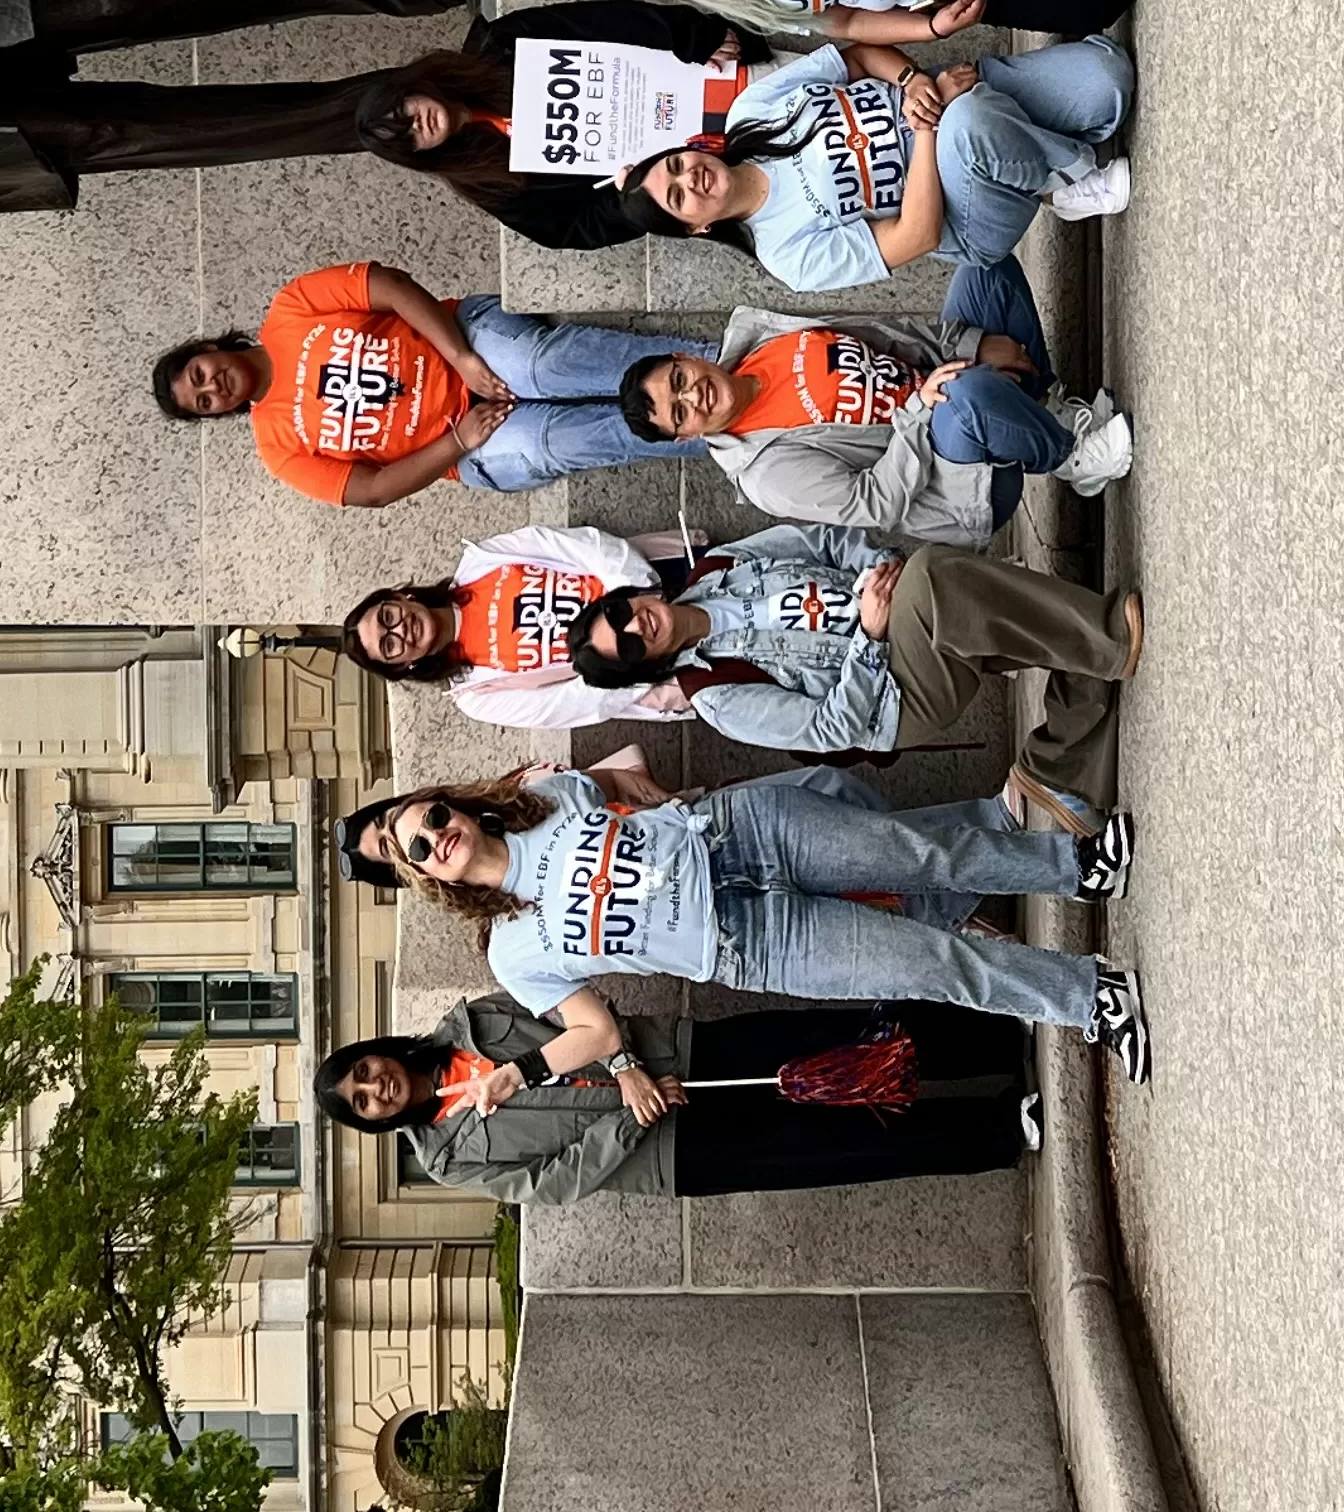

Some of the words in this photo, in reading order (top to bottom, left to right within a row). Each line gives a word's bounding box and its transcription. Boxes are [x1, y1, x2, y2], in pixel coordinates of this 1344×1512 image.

[542, 48, 582, 165] $550M
[586, 51, 604, 99] EBF
[608, 56, 621, 160] #FundtheFormula
[664, 92, 674, 130] FUTURE
[584, 112, 603, 162] FOR
[802, 84, 863, 216] FUNDING
[845, 82, 902, 210] FUTURE
[295, 360, 306, 385] EBF
[318, 328, 354, 450] FUNDING
[352, 334, 388, 452] FUTURE
[404, 356, 424, 437] #FundtheFormula
[834, 334, 863, 424] FUNDIN
[517, 564, 544, 672] UNDING
[534, 884, 544, 902] for
[536, 852, 550, 880] EBF
[545, 840, 556, 852] in
[562, 812, 608, 956] FUNDING
[604, 822, 646, 956] FUTURE
